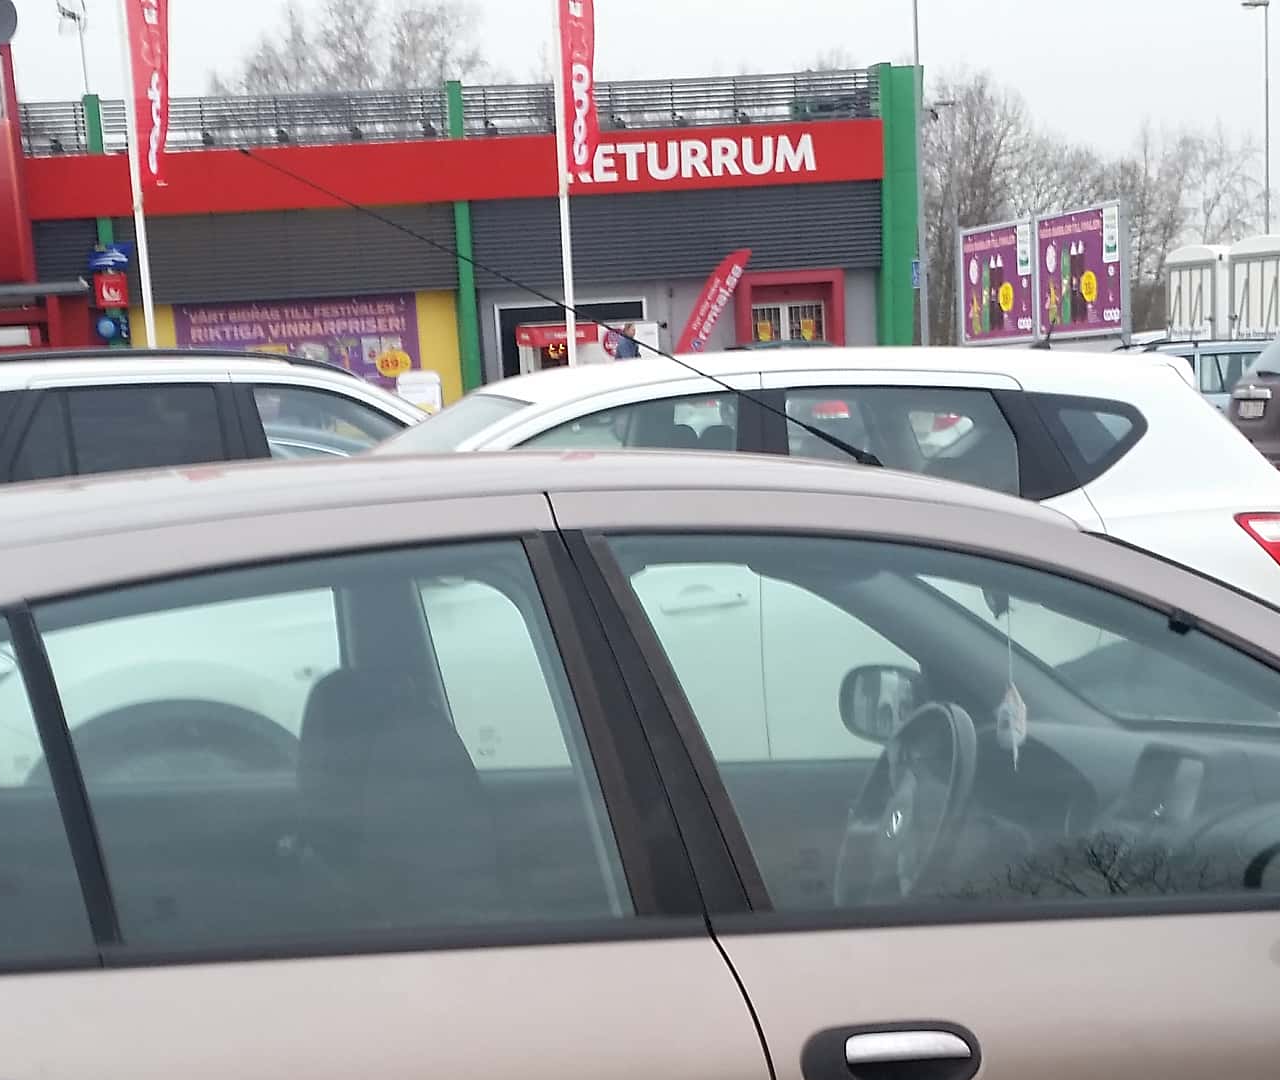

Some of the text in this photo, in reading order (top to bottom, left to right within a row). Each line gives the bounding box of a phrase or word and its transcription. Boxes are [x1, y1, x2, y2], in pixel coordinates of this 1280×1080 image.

[572, 63, 591, 166] coop
[190, 316, 407, 343] RIKTIGA VINNARPRISER!
